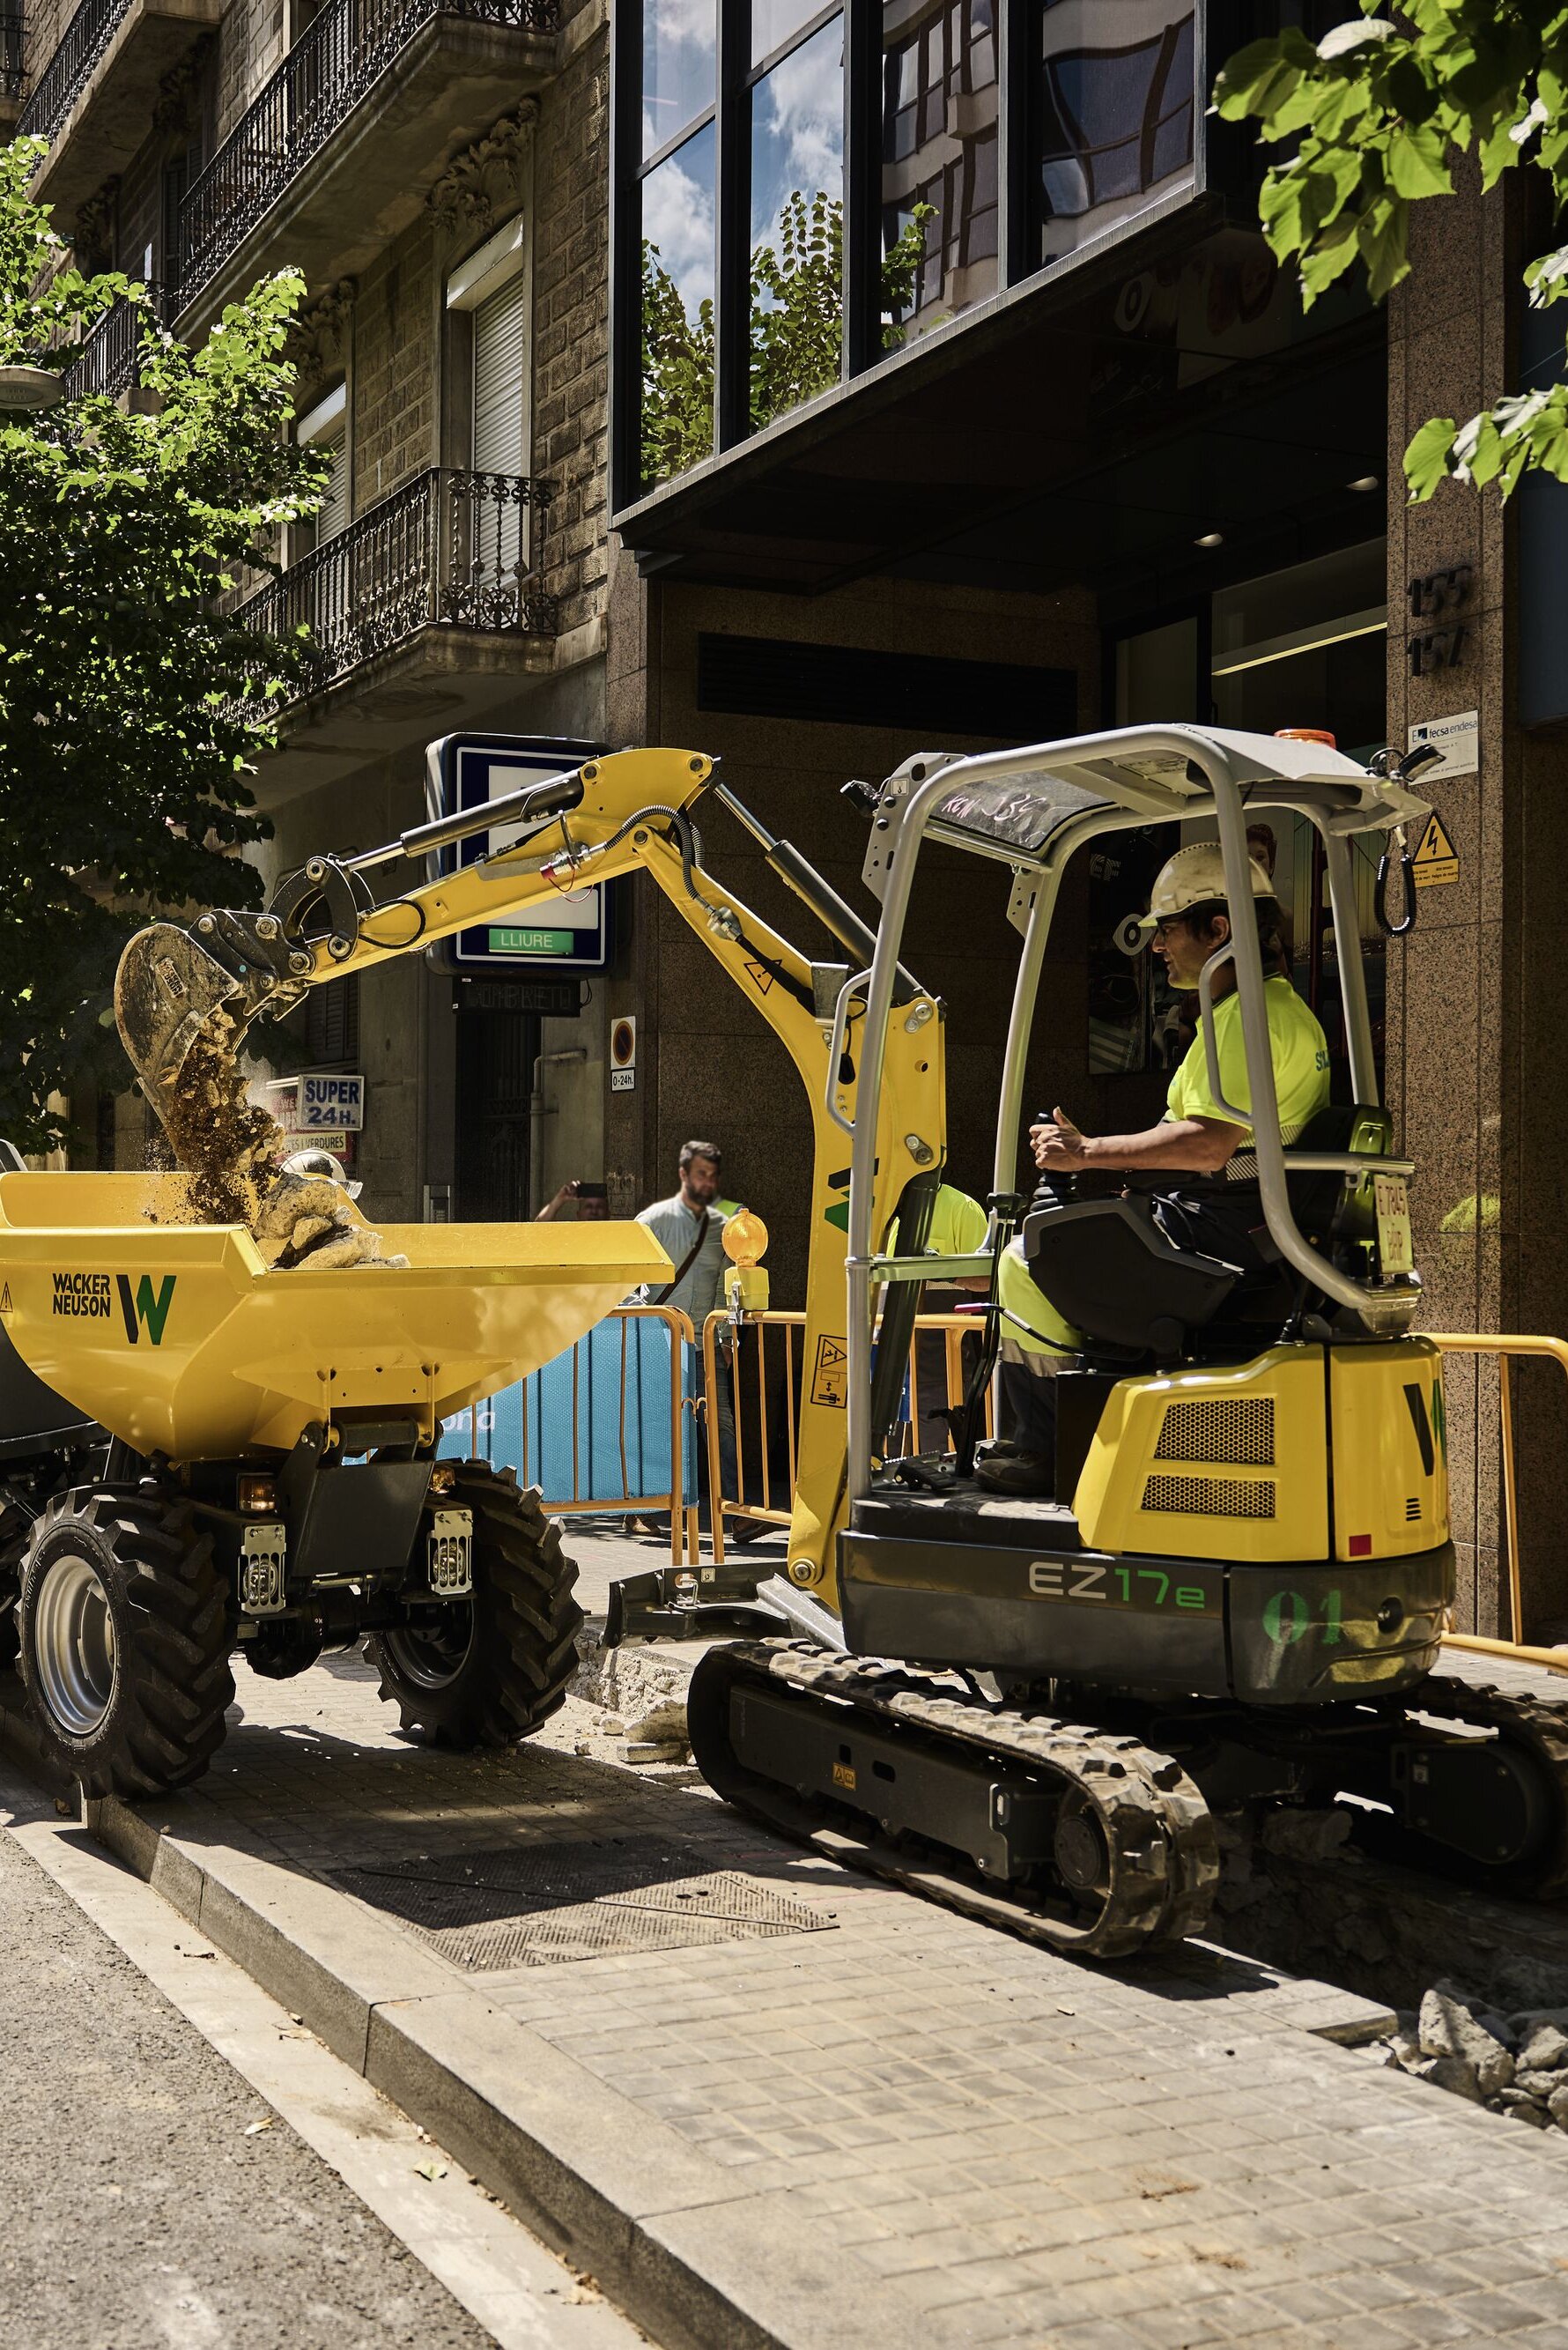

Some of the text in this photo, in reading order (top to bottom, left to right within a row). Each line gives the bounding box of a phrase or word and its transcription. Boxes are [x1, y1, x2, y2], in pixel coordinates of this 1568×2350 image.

[500, 932, 553, 948] LLIURE
[305, 1079, 359, 1105] SUPER
[52, 1272, 111, 1296] WACKER
[52, 1294, 111, 1317] NEUSON
[1028, 1561, 1206, 1609] EZ17e
[1261, 1589, 1342, 1646] 01
